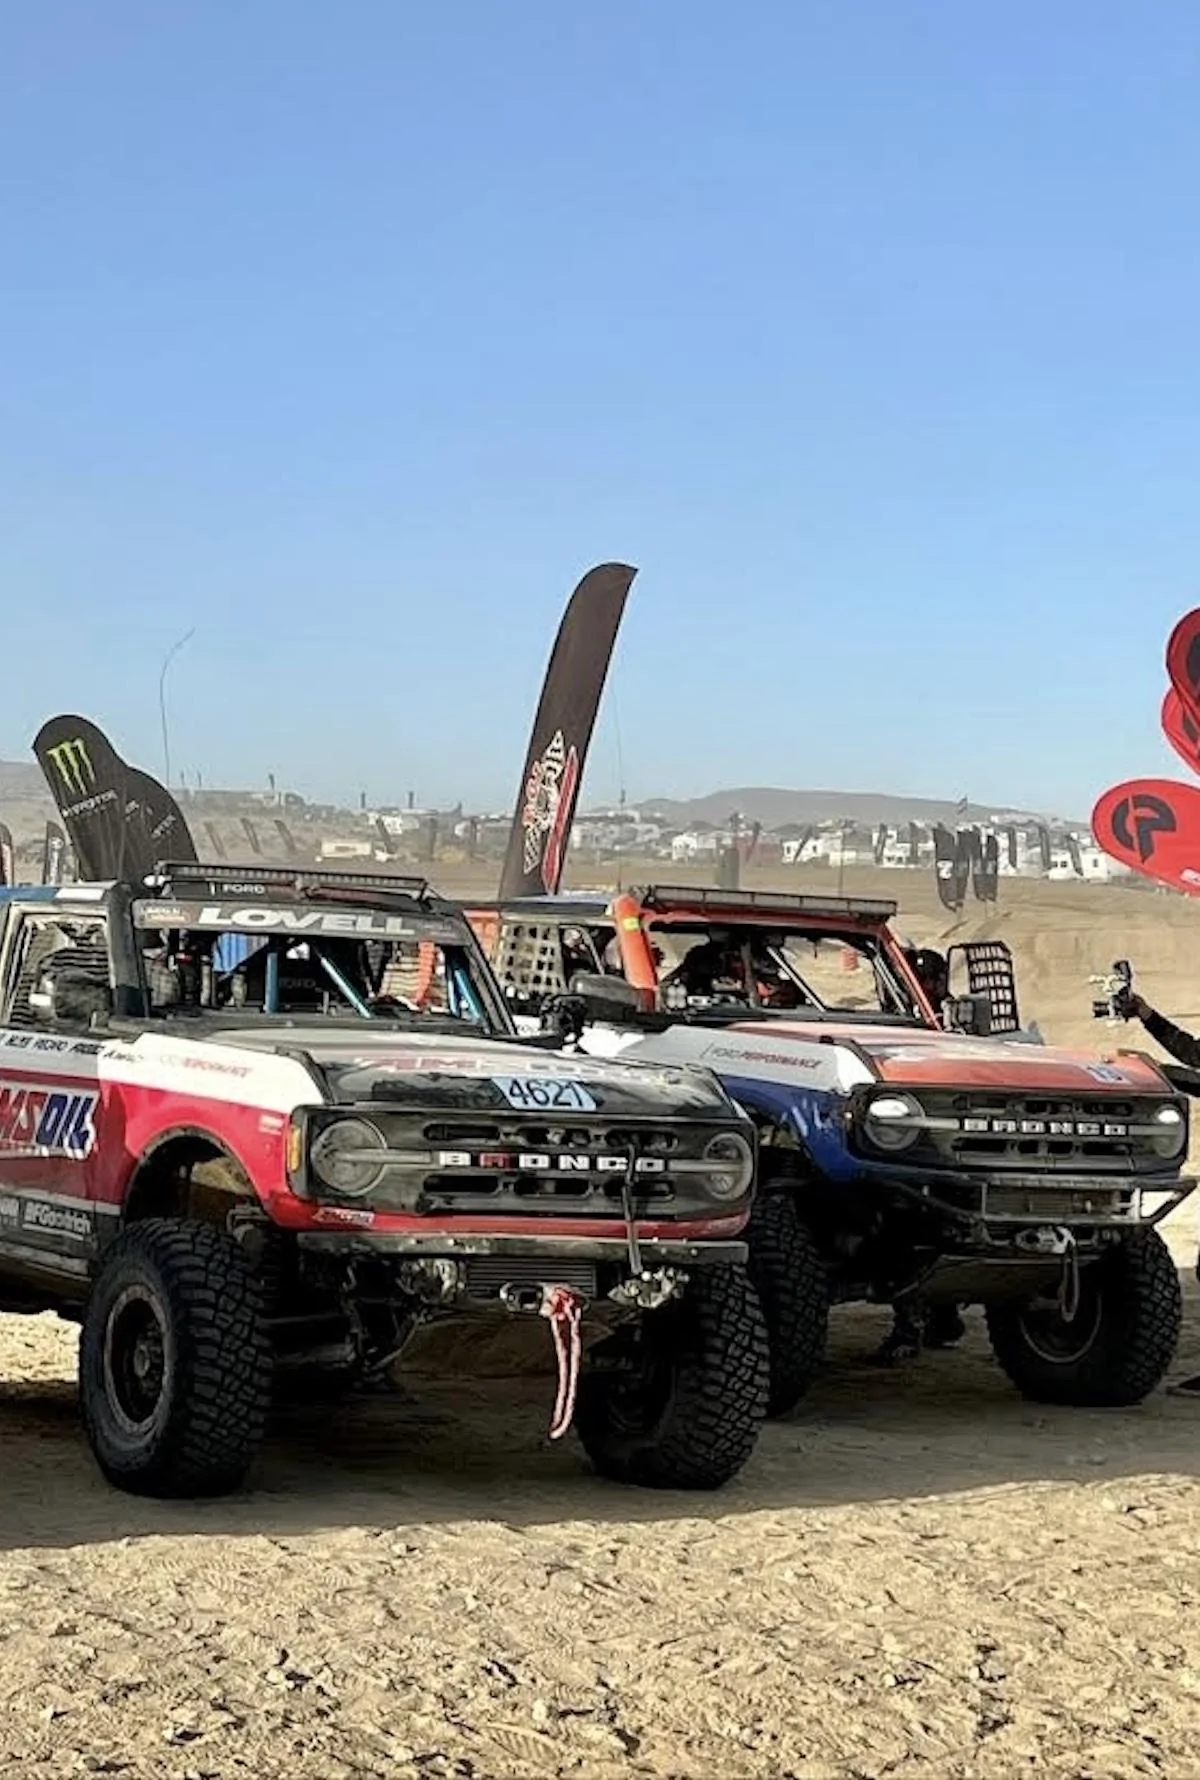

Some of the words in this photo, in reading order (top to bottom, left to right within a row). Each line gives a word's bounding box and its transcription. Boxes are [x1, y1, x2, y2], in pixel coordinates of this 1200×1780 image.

[222, 883, 265, 895] FORD
[199, 908, 415, 935] LOVELL
[508, 1078, 584, 1107] 4621
[963, 1117, 1127, 1137] BRONCO
[438, 1149, 666, 1173] BRONCO
